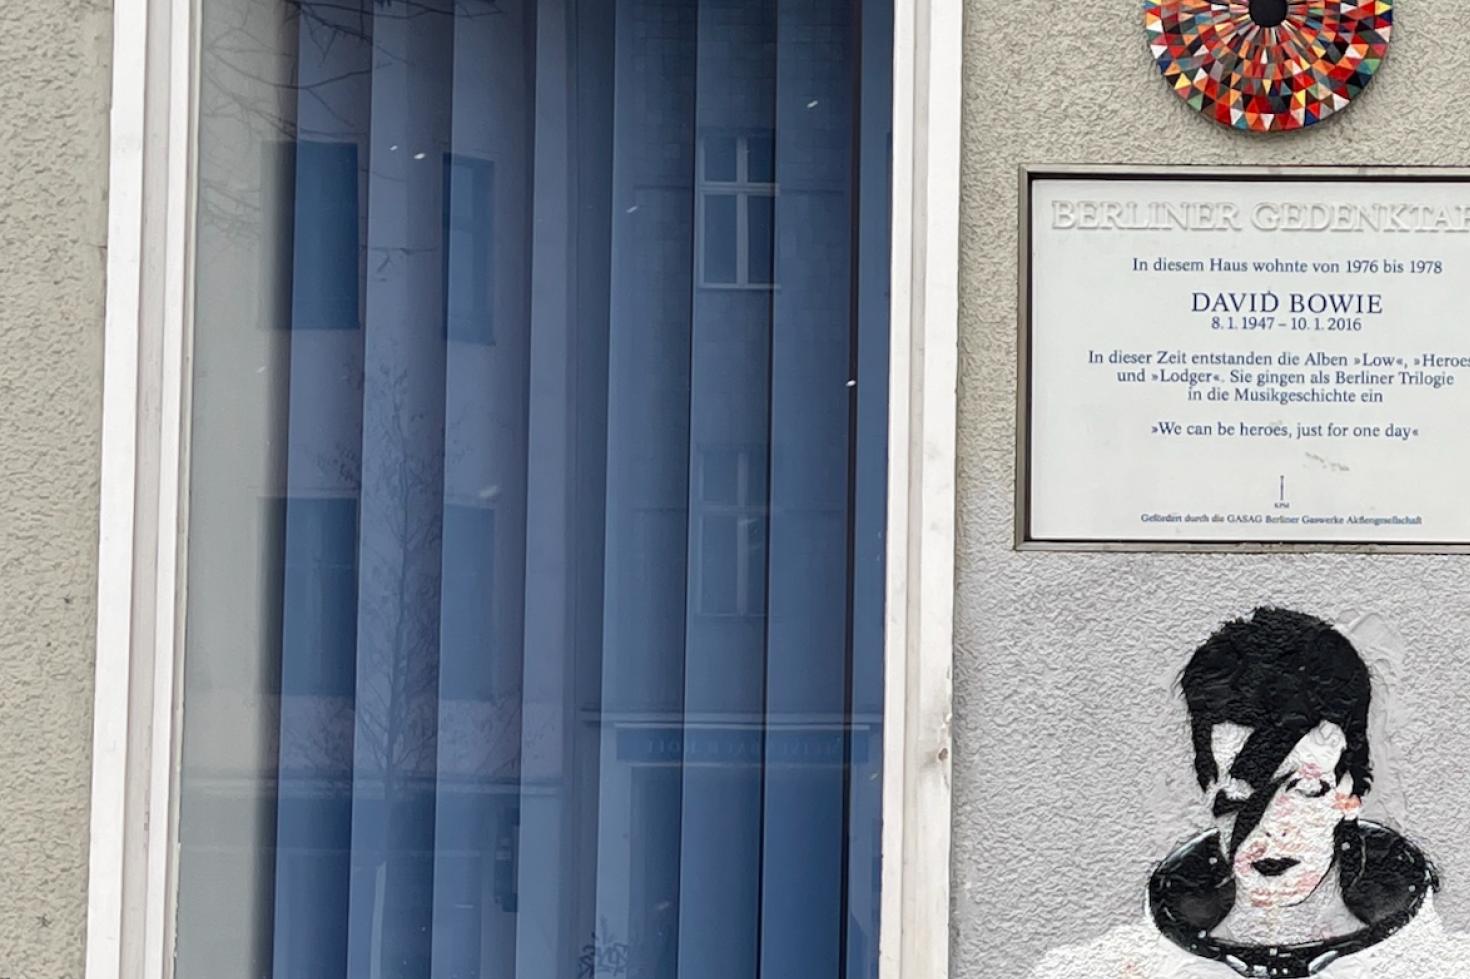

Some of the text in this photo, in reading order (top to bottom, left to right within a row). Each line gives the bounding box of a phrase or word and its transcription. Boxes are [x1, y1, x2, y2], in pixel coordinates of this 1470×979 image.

[1051, 200, 1242, 232] BERLINER
[1133, 257, 1443, 274] In diesem Haus wohnte von 1976 bis 1978
[1191, 291, 1384, 314] DAVID BOWIE
[1088, 350, 1104, 364] In
[1108, 350, 1153, 364] dieser
[1156, 350, 1188, 364] Zeit
[1191, 351, 1273, 366] entstanden
[1277, 352, 1301, 366] die
[1304, 352, 1348, 366] Alben
[1117, 369, 1146, 382] und
[1229, 369, 1253, 383] Sie
[1256, 370, 1306, 387] gingen
[1309, 371, 1331, 384] als
[1335, 371, 1395, 385] Berliner
[1398, 372, 1455, 389] Trilogie
[1187, 387, 1384, 405] in die Musikgeschichte ein
[1151, 421, 1419, 440] »We can be heroes, just for one day«
[1184, 513, 1210, 524] durch
[1211, 514, 1225, 524] die
[1226, 514, 1263, 525] GASAG
[1264, 514, 1300, 525] Berliner
